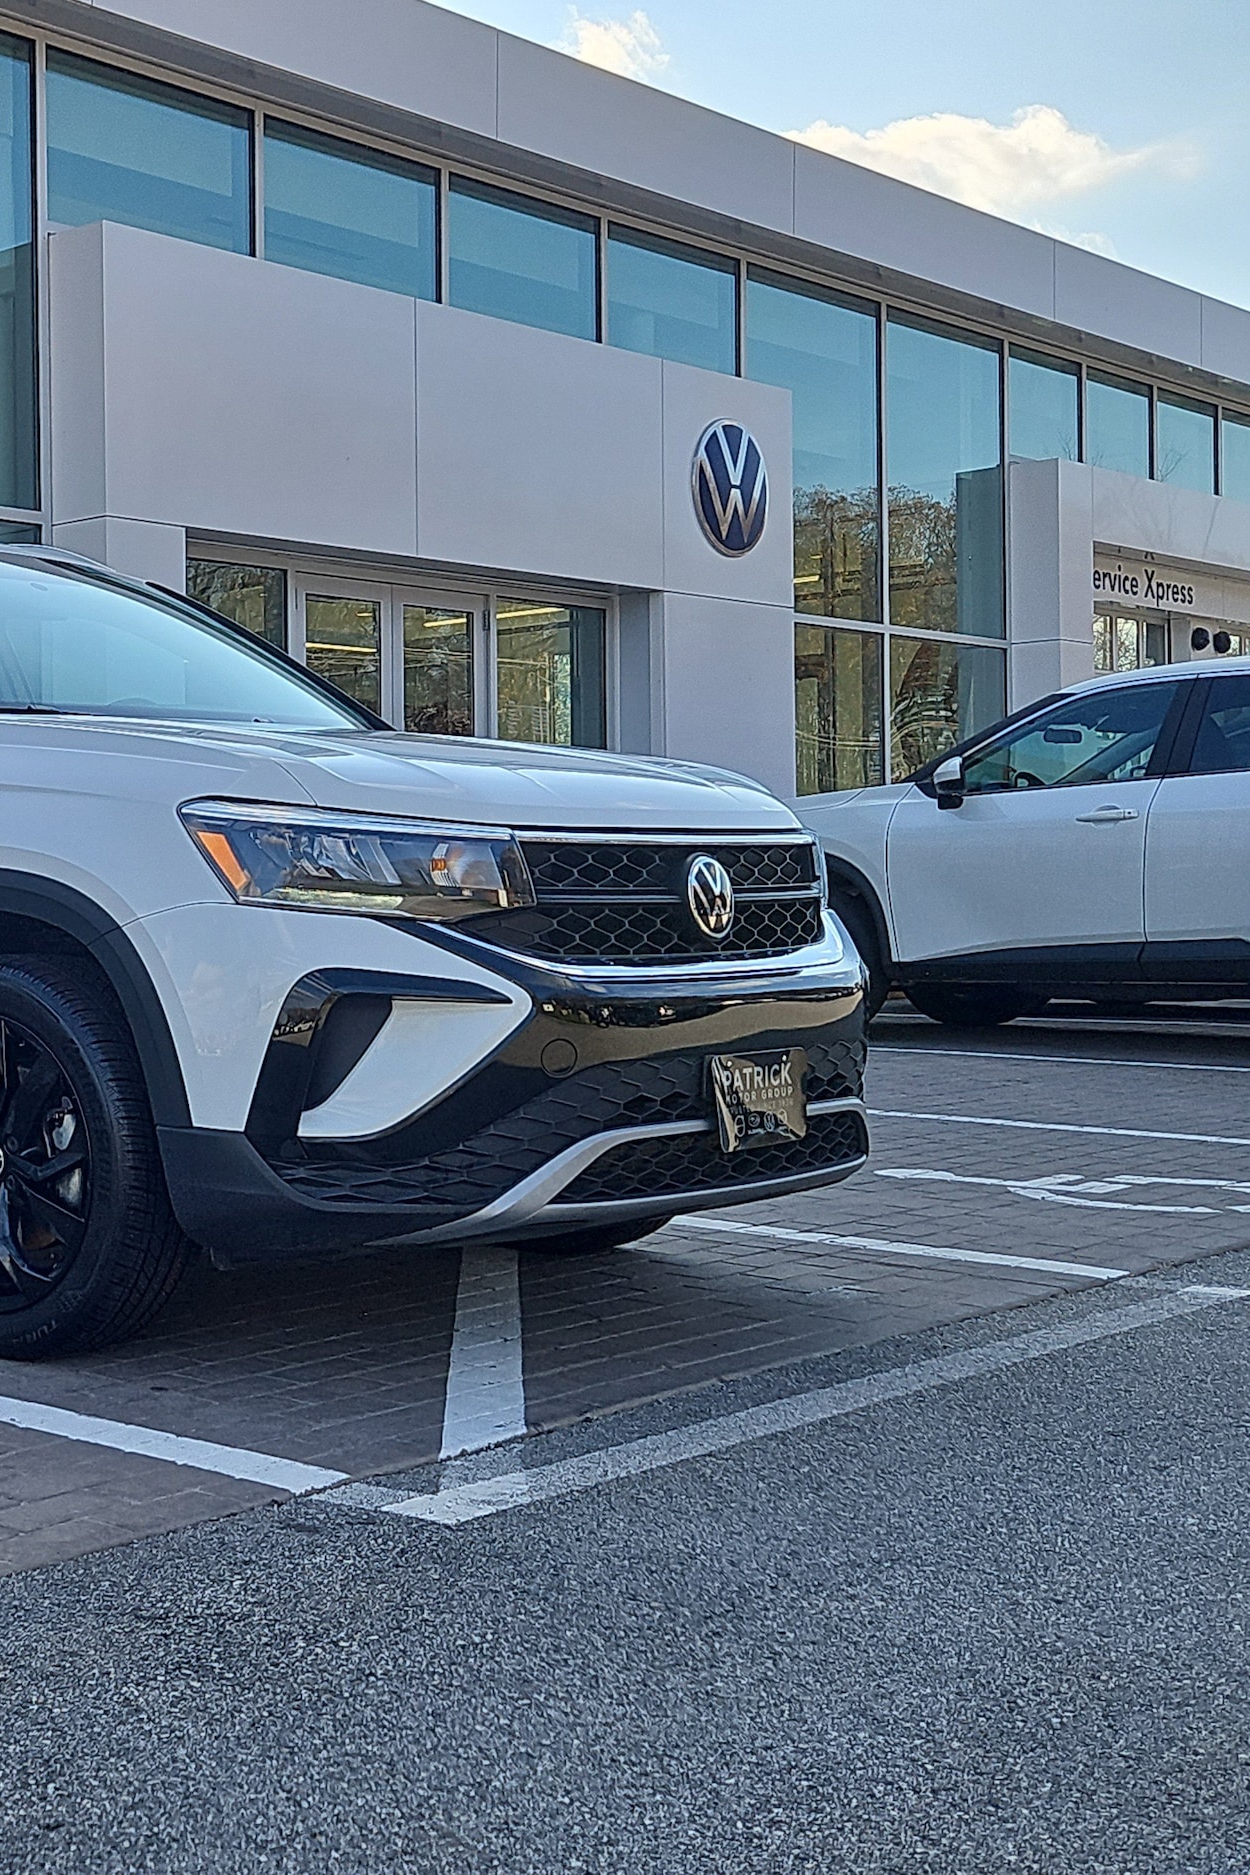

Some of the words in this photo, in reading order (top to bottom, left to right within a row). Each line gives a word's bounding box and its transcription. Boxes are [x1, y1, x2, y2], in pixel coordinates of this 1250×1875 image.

[1092, 564, 1139, 596] ervice
[1144, 568, 1194, 607] Xpress
[722, 1062, 792, 1093] PATRICK
[725, 1090, 757, 1105] MOTOR
[761, 1086, 793, 1100] GROUP
